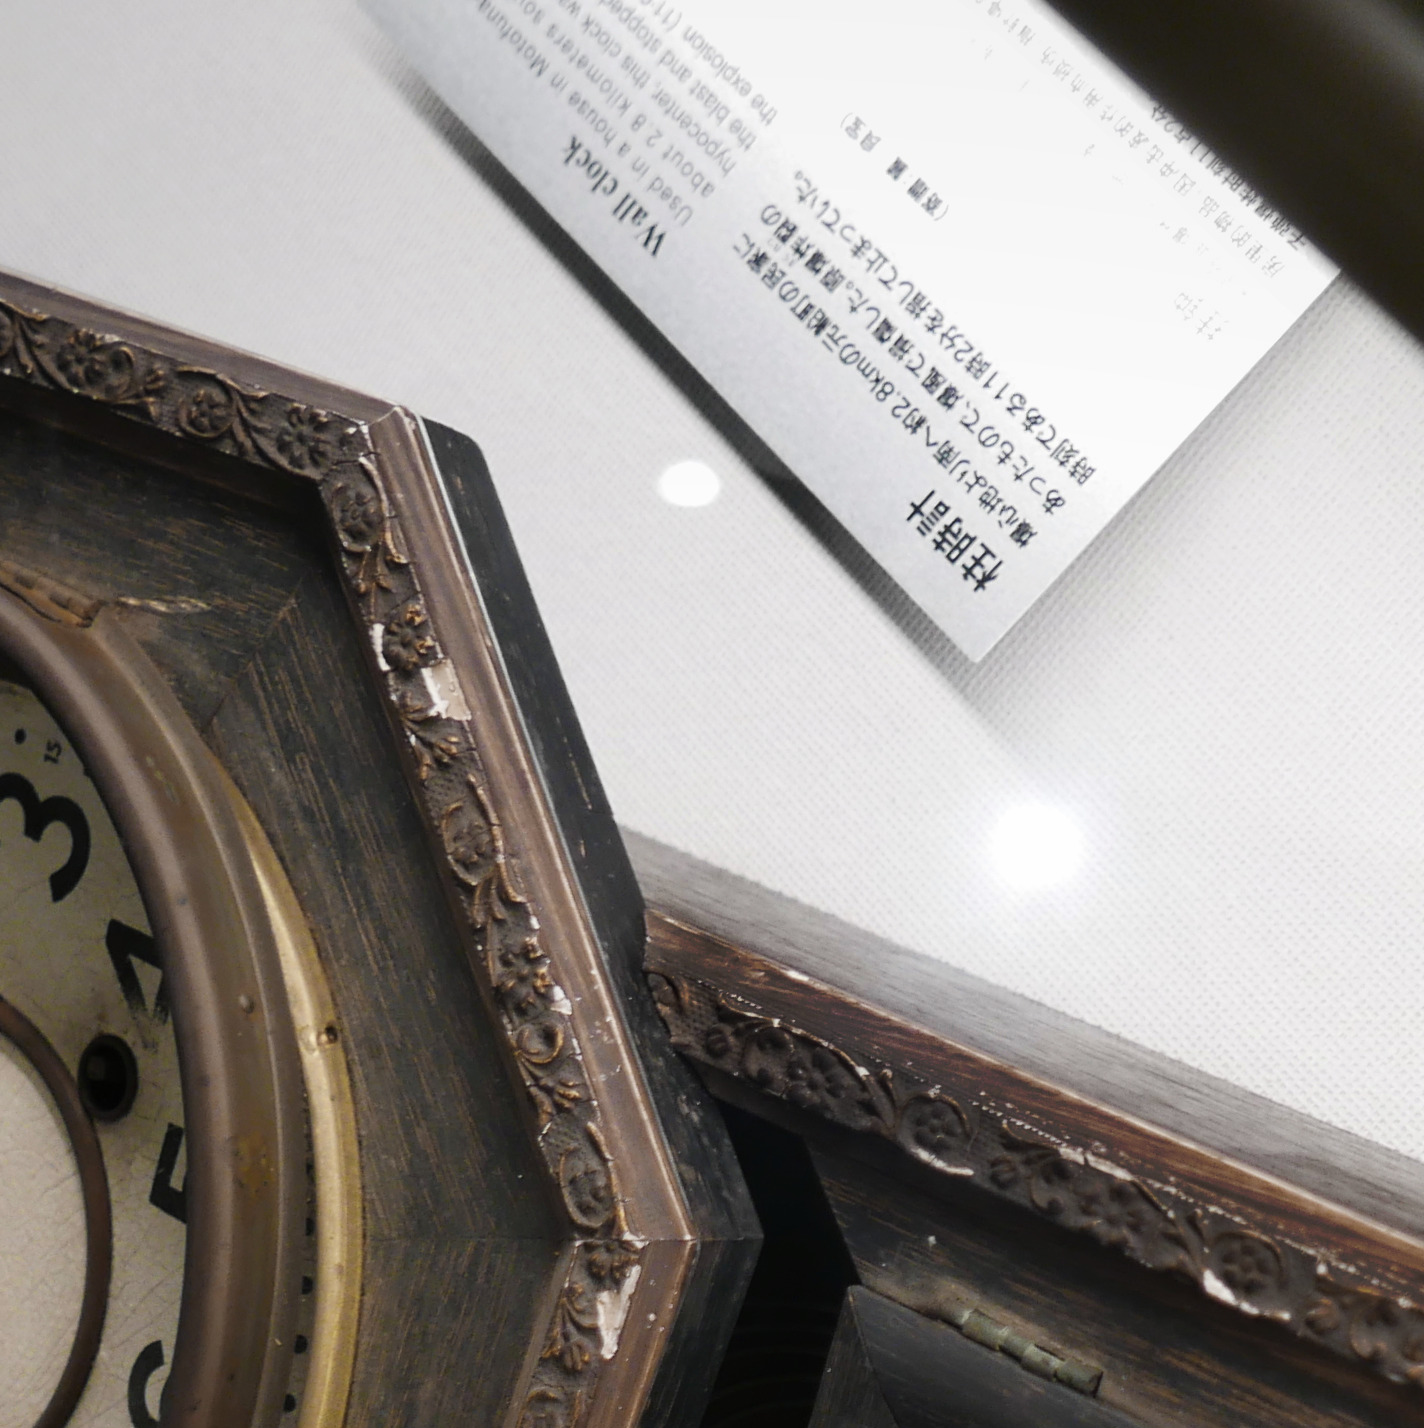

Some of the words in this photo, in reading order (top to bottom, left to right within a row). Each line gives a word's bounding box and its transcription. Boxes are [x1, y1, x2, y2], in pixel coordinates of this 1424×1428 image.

[575, 12, 624, 64] clock
[678, 21, 755, 103] explosion
[540, 19, 634, 118] kilometers
[544, 70, 570, 97] in
[615, 52, 652, 92] this
[655, 47, 694, 89] and
[562, 88, 619, 148] house
[685, 76, 732, 126] blast
[745, 90, 780, 127] the
[614, 140, 632, 159] a
[723, 115, 759, 153] the
[554, 133, 622, 205] clock
[626, 154, 651, 182] in
[658, 141, 717, 202] about
[609, 190, 674, 258] Wall
[644, 173, 696, 227] Used
[900, 484, 1007, 596] 柱時計
